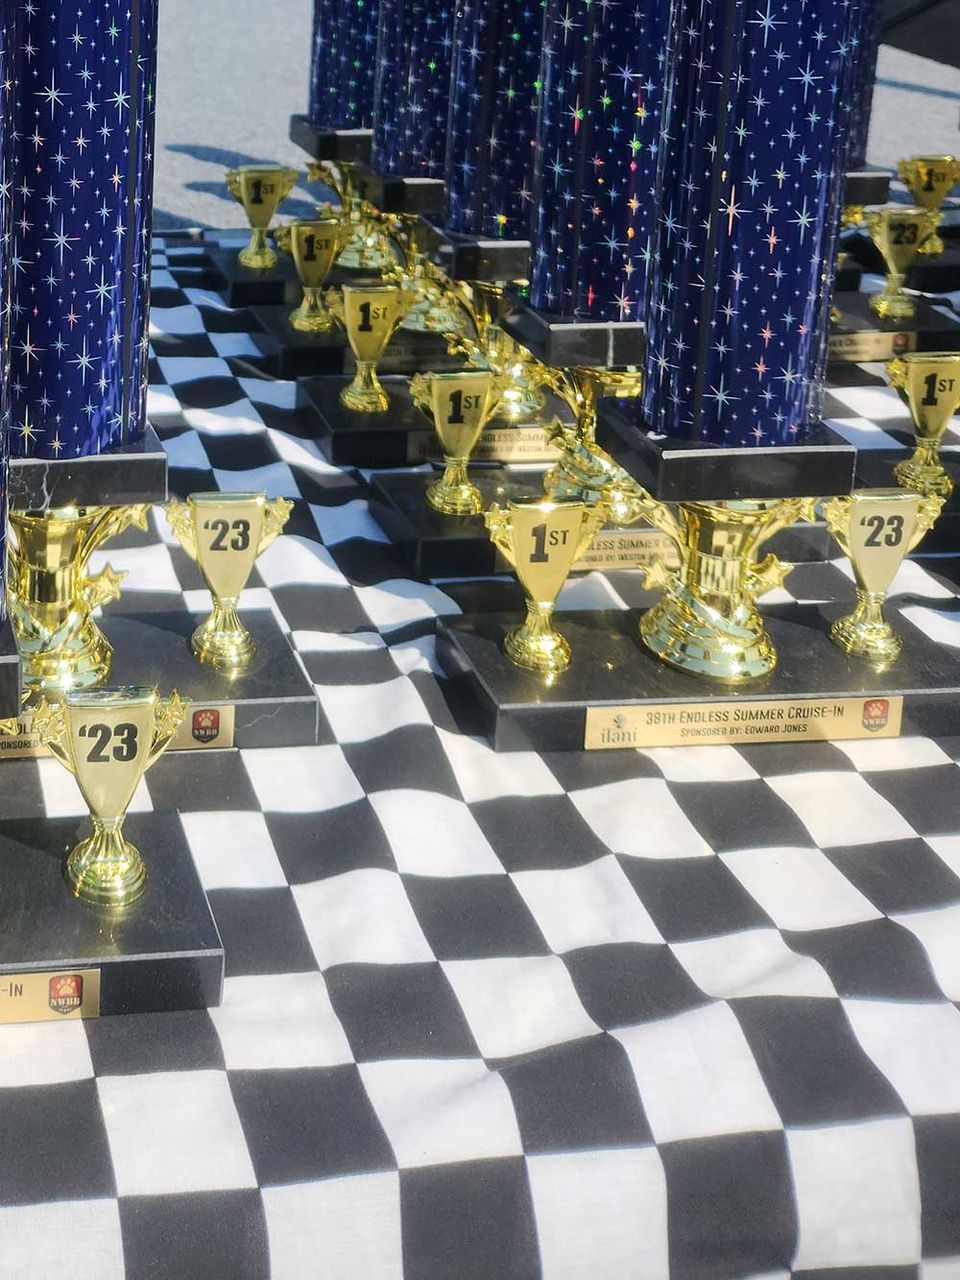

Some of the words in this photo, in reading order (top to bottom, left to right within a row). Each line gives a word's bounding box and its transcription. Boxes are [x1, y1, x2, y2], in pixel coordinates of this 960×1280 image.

[251, 180, 275, 204] 1ST
[304, 234, 330, 261] 1ST
[358, 301, 388, 332] 1ST
[921, 373, 956, 406] 1ST
[447, 389, 481, 424] 1ST
[203, 519, 250, 551] '23
[529, 523, 569, 563] 1ST
[860, 515, 904, 547] '23
[646, 712, 676, 725] 38TH
[680, 710, 729, 723] ENDLESS
[733, 707, 784, 721] SUMMER
[788, 704, 844, 719] CRUISE-IN
[78, 722, 137, 762] '23
[601, 728, 637, 744] ilani
[680, 727, 727, 738] SPONSORED
[745, 724, 780, 734] EDWARD
[782, 724, 807, 733] JONES
[50, 997, 80, 1006] NWBB
